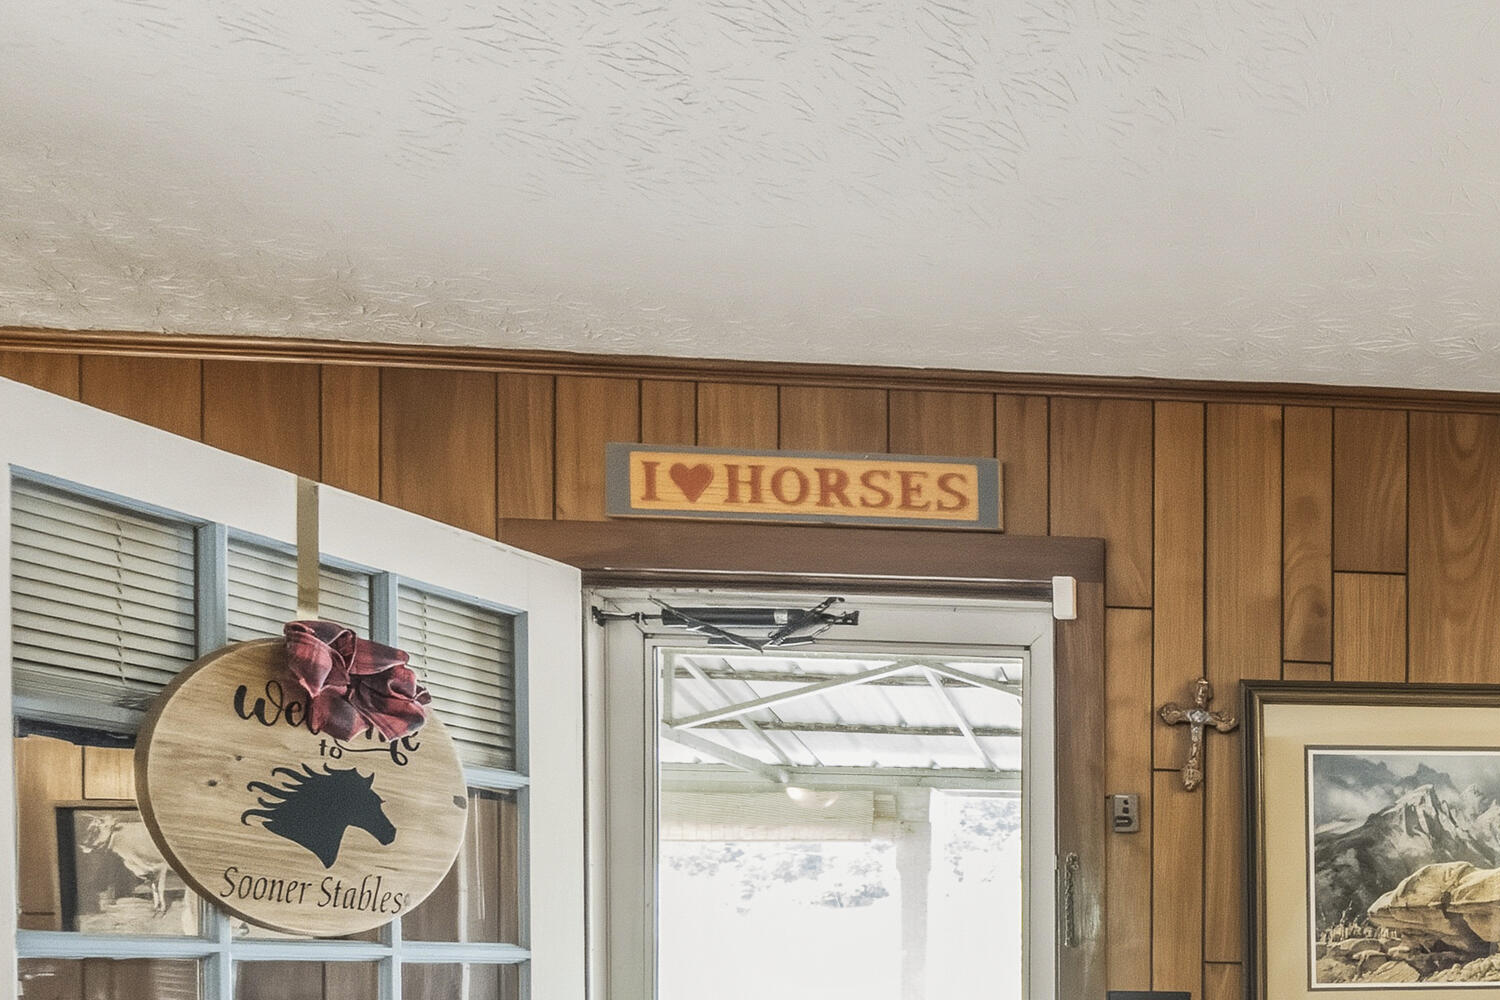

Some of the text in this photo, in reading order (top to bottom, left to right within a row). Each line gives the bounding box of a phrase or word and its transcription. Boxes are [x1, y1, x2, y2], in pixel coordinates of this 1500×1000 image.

[640, 461, 970, 512] I HORSES
[319, 739, 343, 759] to
[220, 866, 404, 914] Sooner Stables
